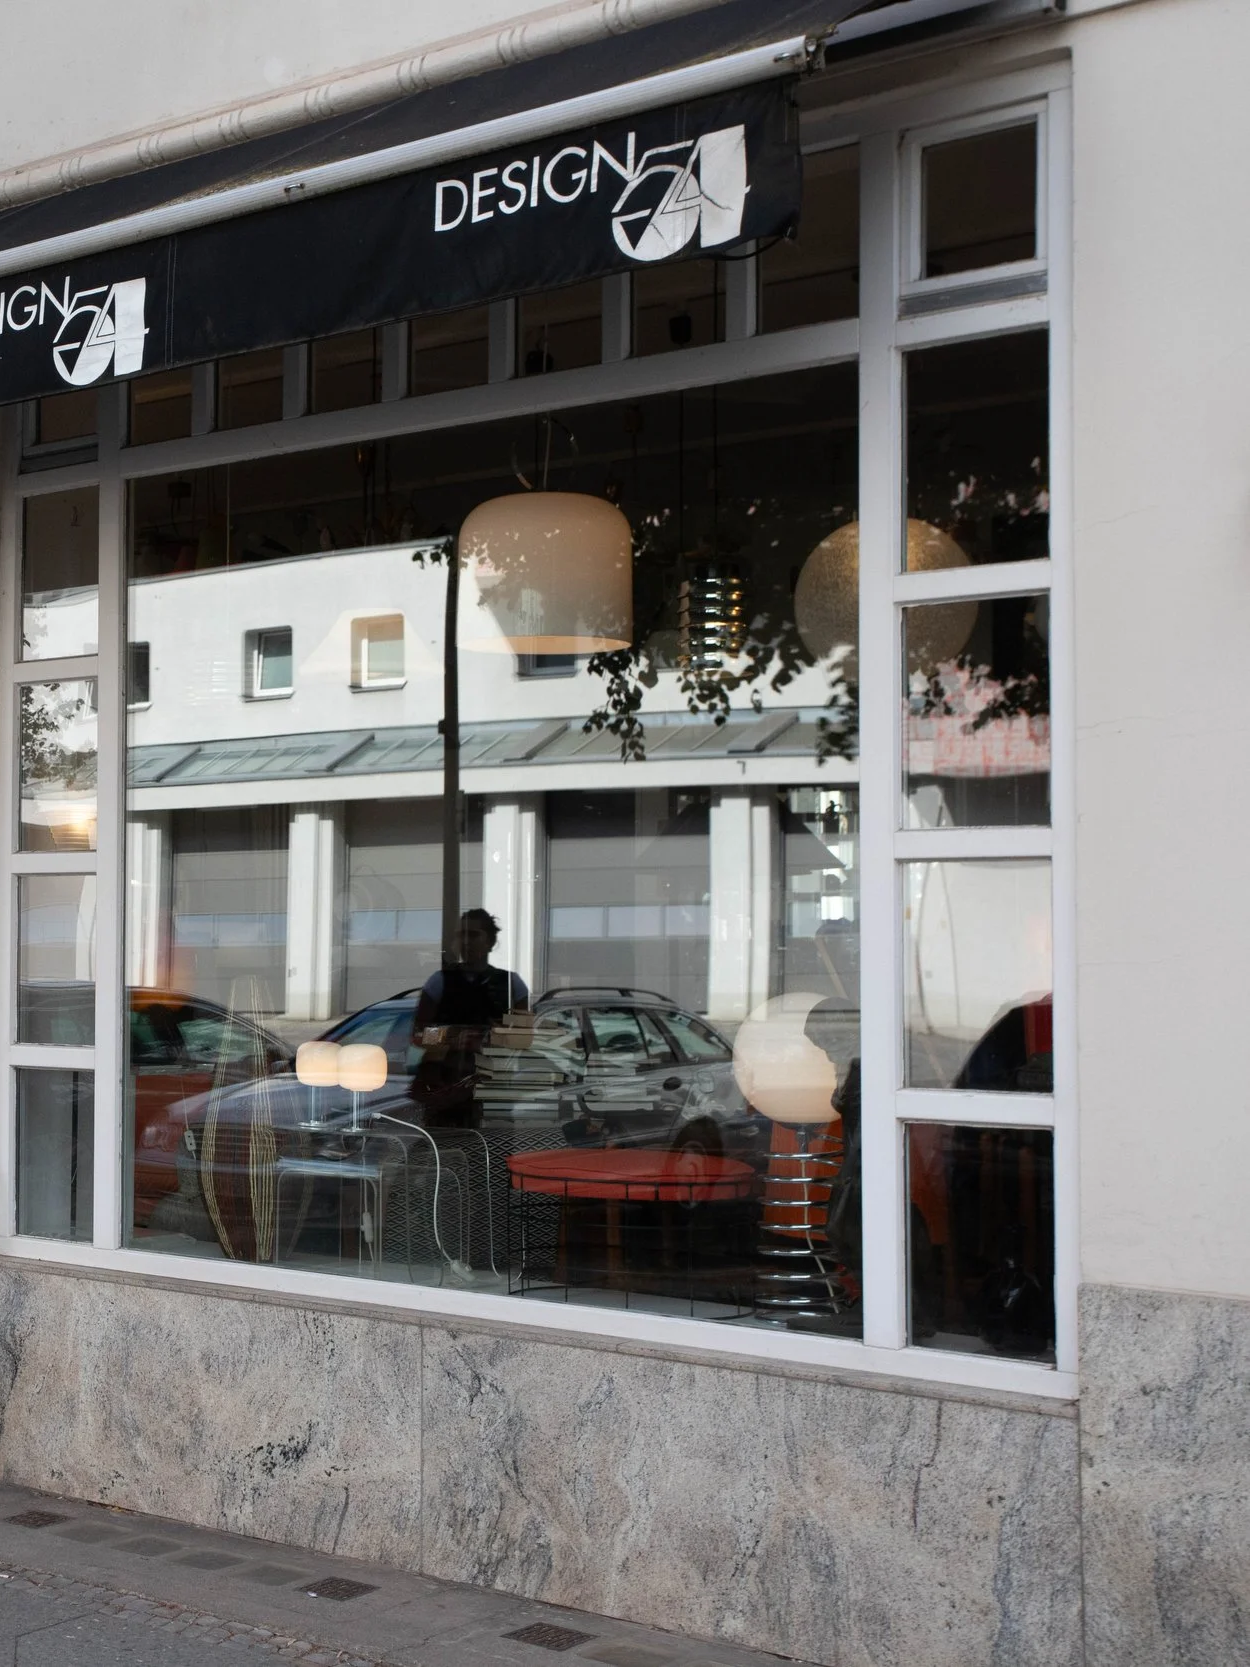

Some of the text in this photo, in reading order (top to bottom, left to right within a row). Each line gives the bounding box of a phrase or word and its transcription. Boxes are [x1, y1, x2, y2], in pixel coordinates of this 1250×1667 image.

[433, 124, 751, 262] DESIGN 54
[53, 277, 150, 386] 54
